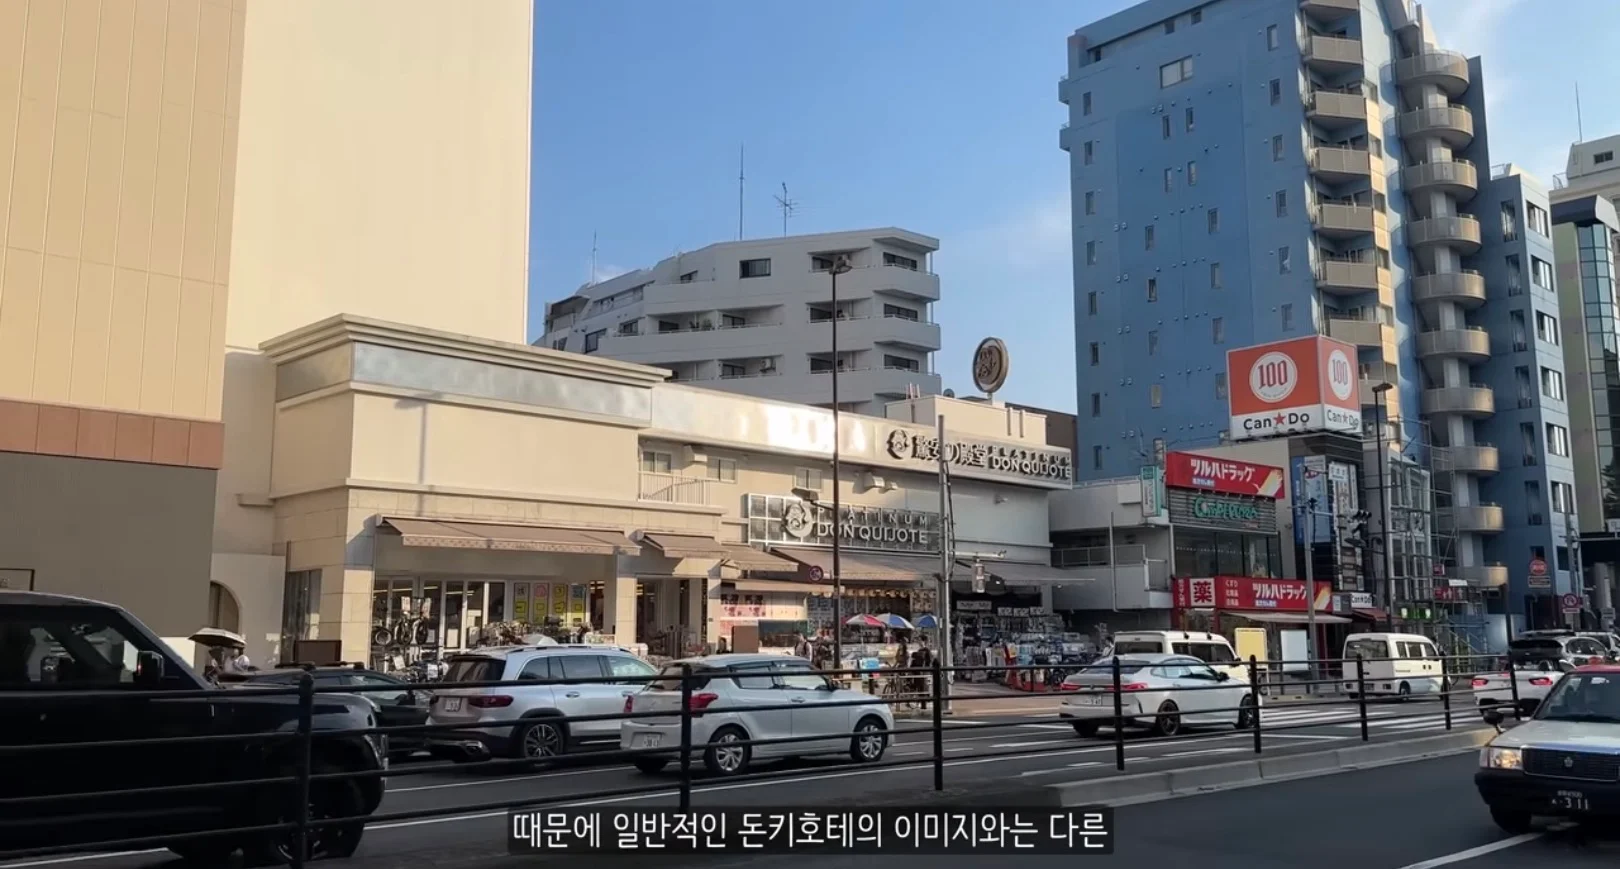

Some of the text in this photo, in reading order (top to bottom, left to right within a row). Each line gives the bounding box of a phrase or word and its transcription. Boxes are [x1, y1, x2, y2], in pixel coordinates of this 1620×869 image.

[1258, 360, 1288, 390] 100
[1332, 358, 1348, 386] 100
[991, 456, 1072, 478] DON QUIJOTE
[1190, 458, 1256, 482] ツルハドラッグ
[817, 504, 928, 525] PATINUM
[817, 524, 929, 544] DON QUIJOTE
[1193, 580, 1213, 603] 薬
[1252, 582, 1307, 600] ツルハドラッグ
